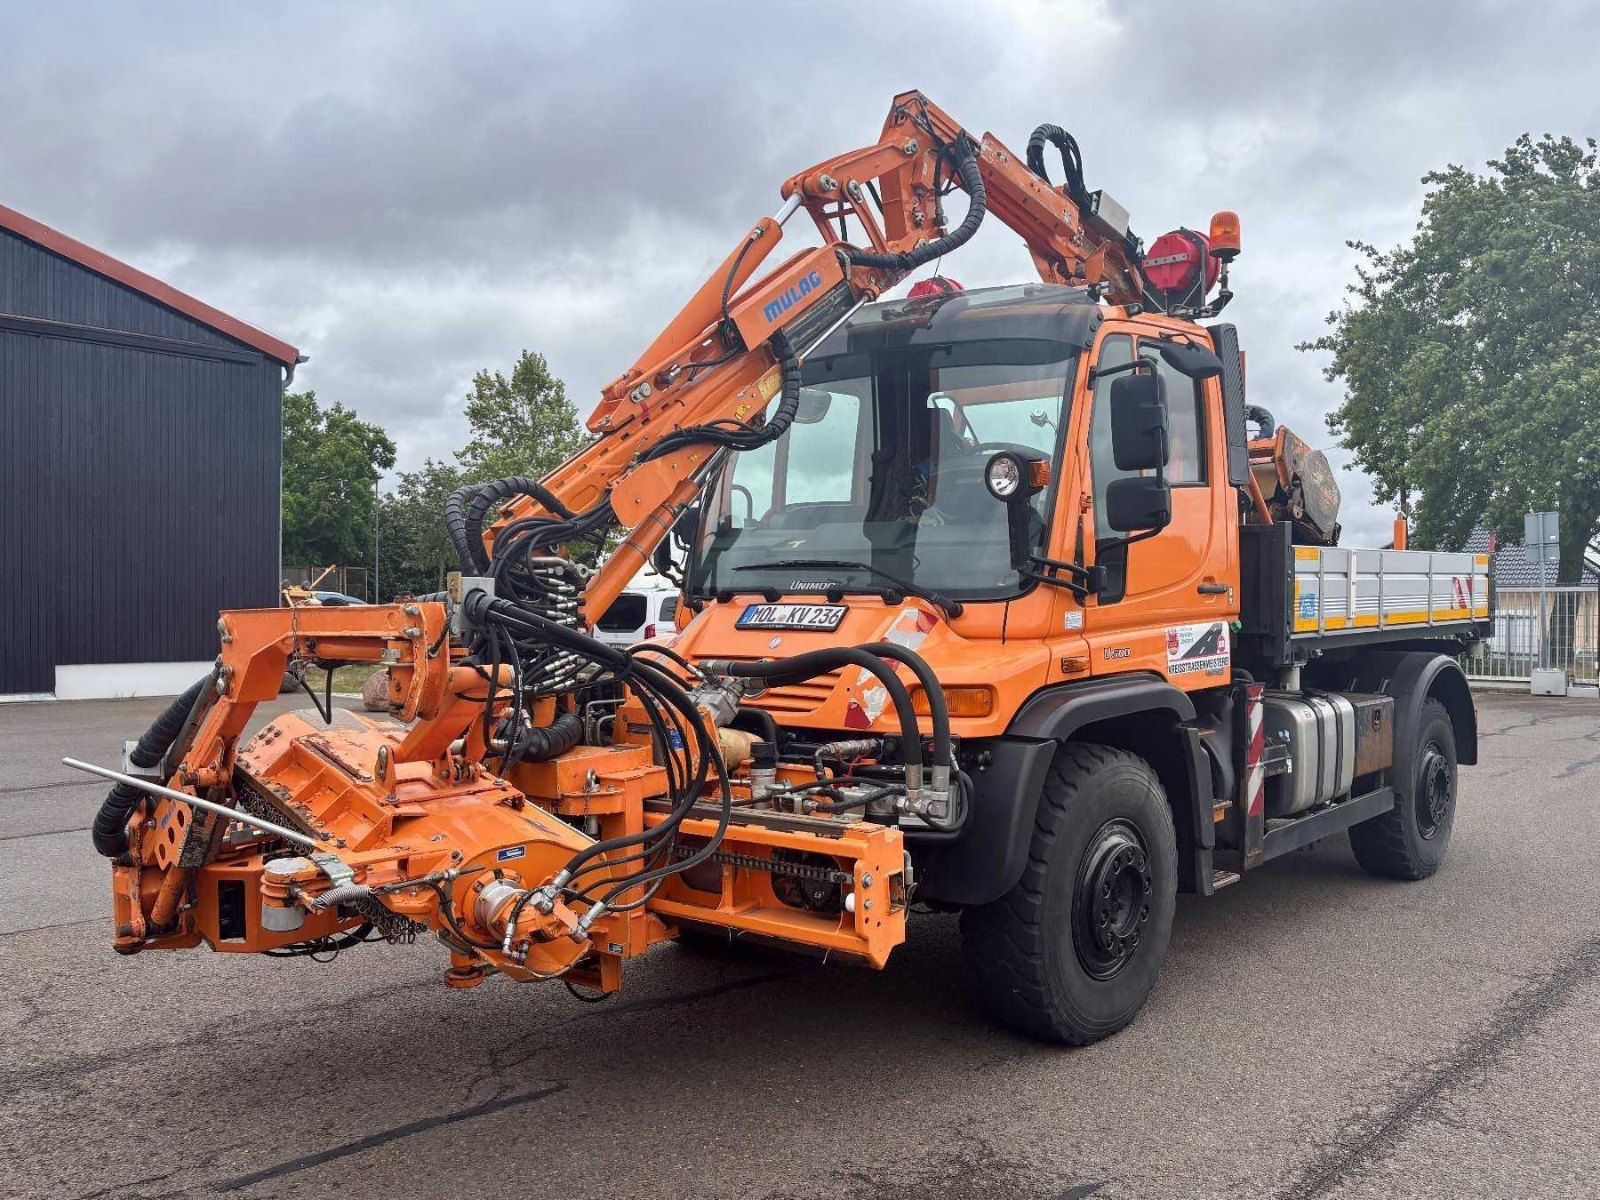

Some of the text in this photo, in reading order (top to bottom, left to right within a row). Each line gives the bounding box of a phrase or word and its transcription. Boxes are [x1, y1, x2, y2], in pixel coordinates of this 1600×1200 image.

[764, 270, 822, 324] MULAG
[749, 606, 842, 625] MOL KV 236
